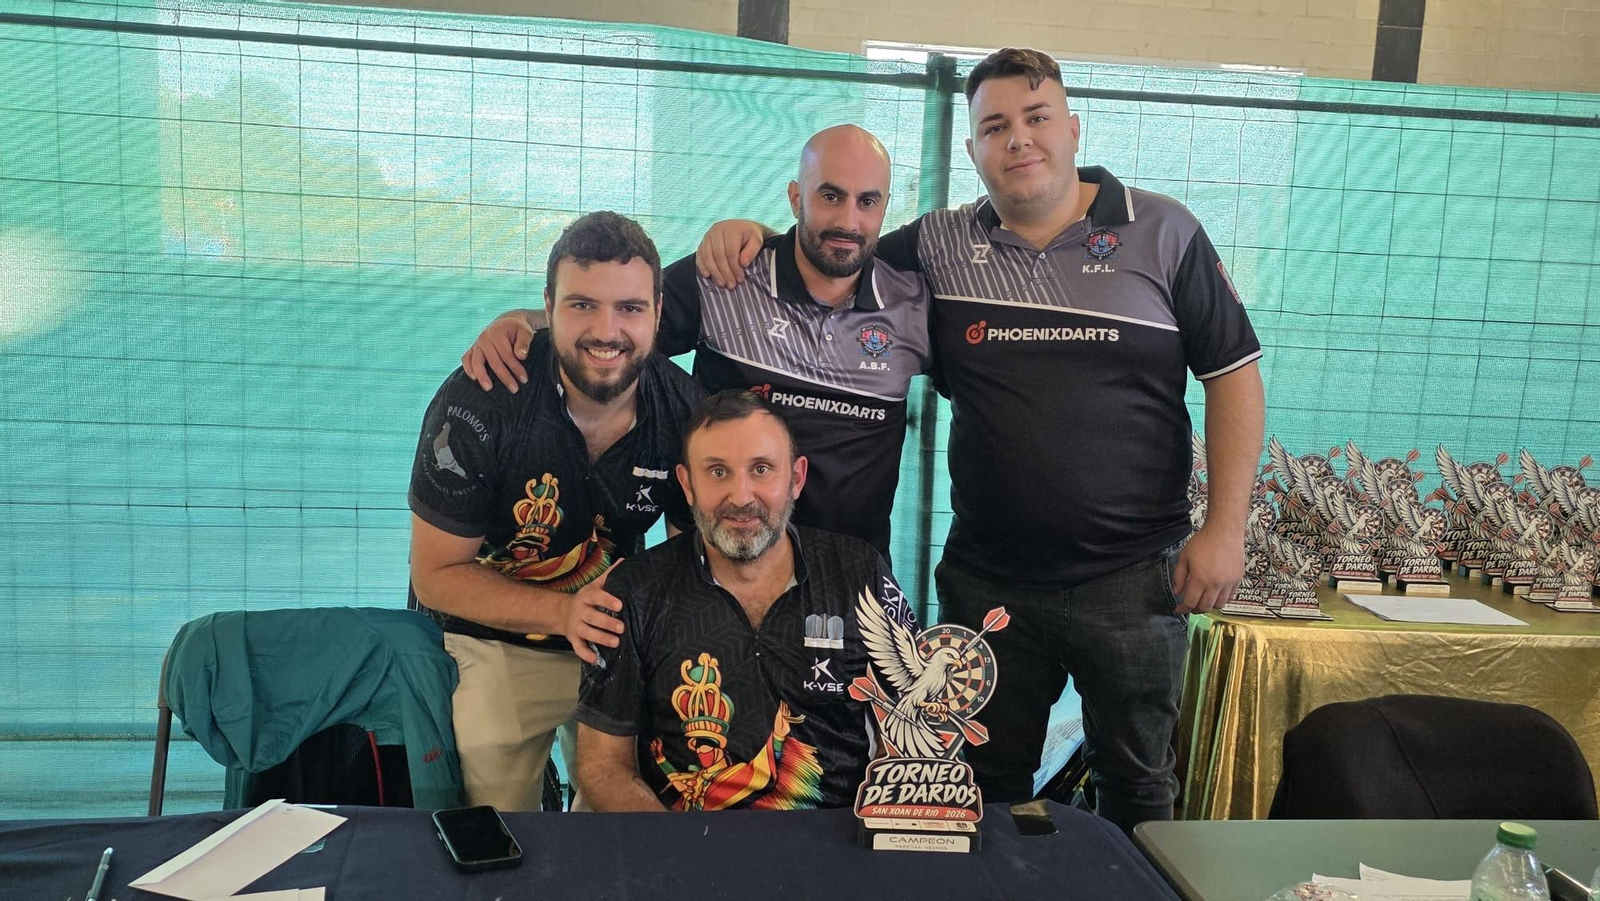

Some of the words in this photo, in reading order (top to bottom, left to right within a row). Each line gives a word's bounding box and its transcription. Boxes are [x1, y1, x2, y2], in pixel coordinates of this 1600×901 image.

[1082, 264, 1115, 273] K.F.L.
[987, 328, 1120, 341] PHOENIXDARTS
[859, 361, 890, 371] A.B.F.
[771, 392, 886, 420] PHOENIXDARTS
[446, 406, 490, 442] PALOMO'S
[1337, 555, 1371, 563] TORNEO
[1461, 551, 1475, 560] DE
[1333, 563, 1345, 571] DE
[1345, 562, 1375, 572] DARDOS
[1403, 558, 1437, 566] TORNEO
[1400, 566, 1411, 575] DE
[1412, 565, 1441, 575] DARDOS
[1506, 569, 1518, 577] DE
[1294, 597, 1319, 605] DARDOS
[803, 680, 844, 692] K-VSE
[873, 762, 966, 784] TORNEO
[862, 784, 896, 808] DE
[896, 783, 977, 808] DARDOS
[871, 807, 889, 815] SAN
[890, 807, 912, 816] XOAN
[913, 808, 924, 817] DE
[924, 808, 939, 817] RIO
[944, 809, 967, 818] 2026
